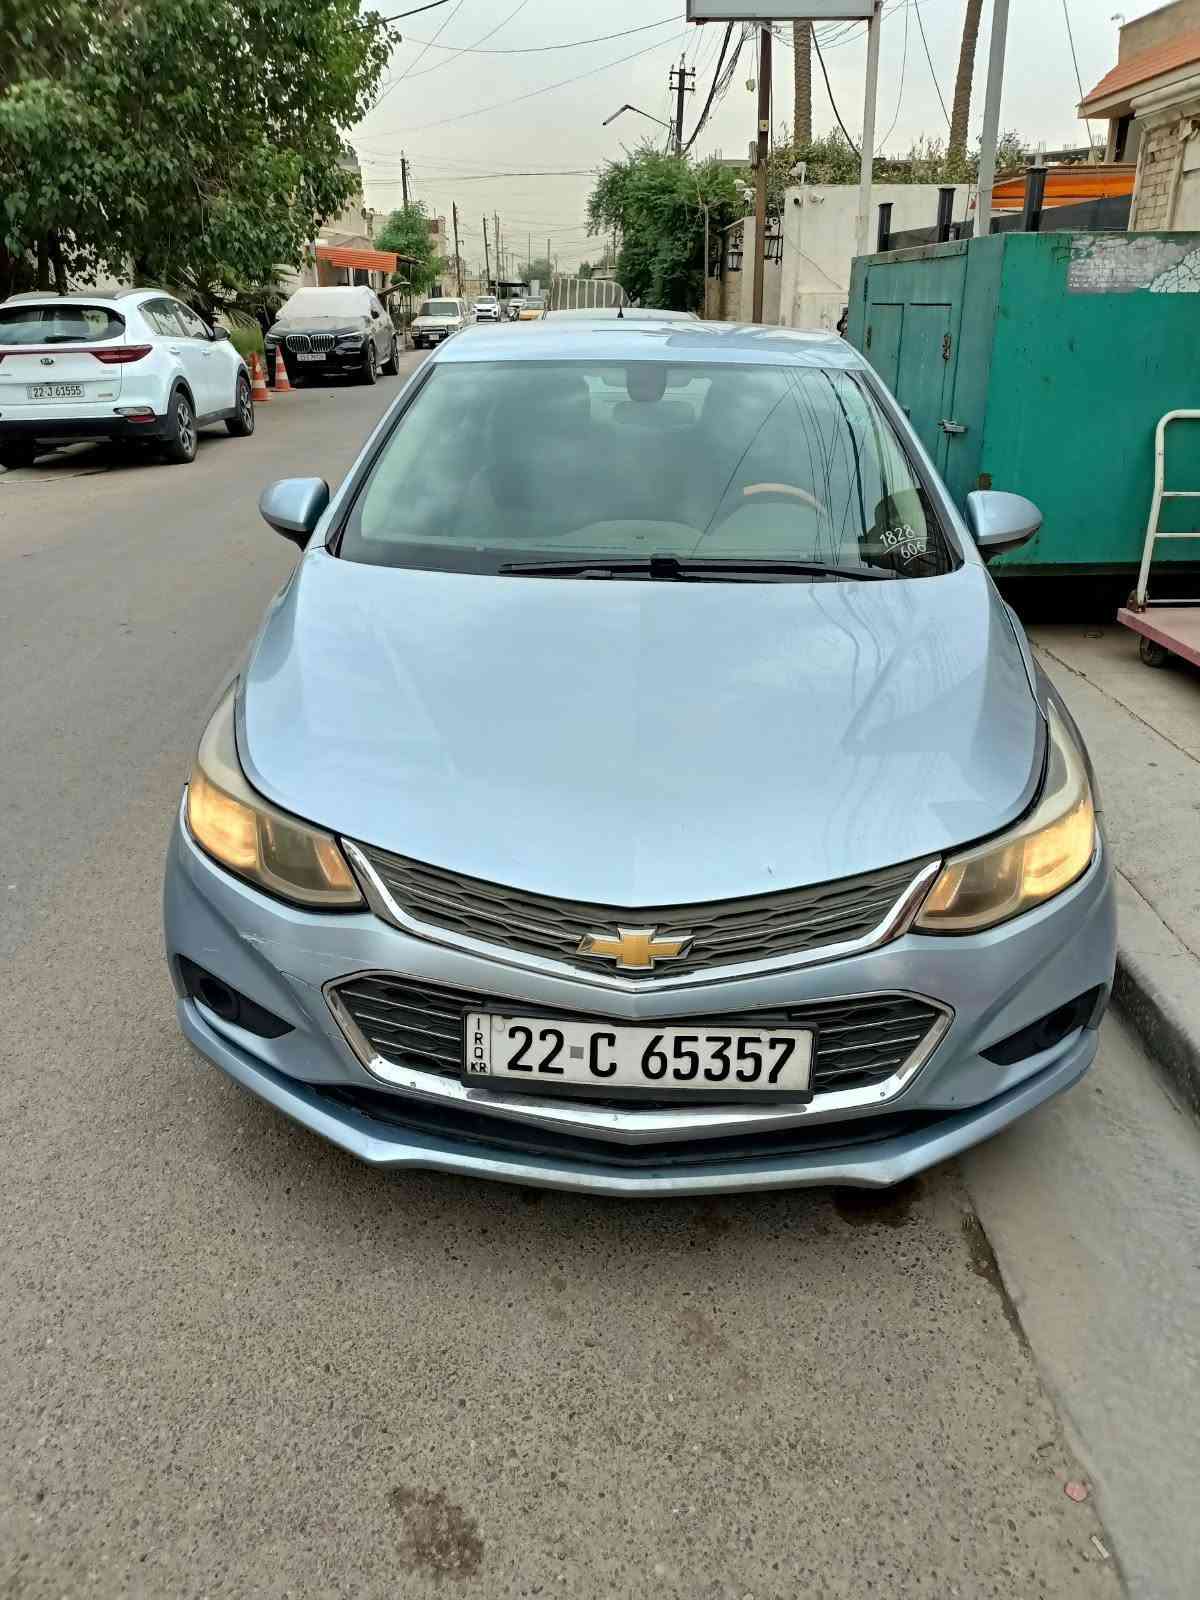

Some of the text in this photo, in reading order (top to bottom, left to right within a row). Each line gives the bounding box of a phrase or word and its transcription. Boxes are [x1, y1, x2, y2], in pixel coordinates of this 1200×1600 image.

[33, 387, 44, 398] 22
[880, 524, 914, 548] 1828
[507, 1026, 796, 1083] 22 C 65357
